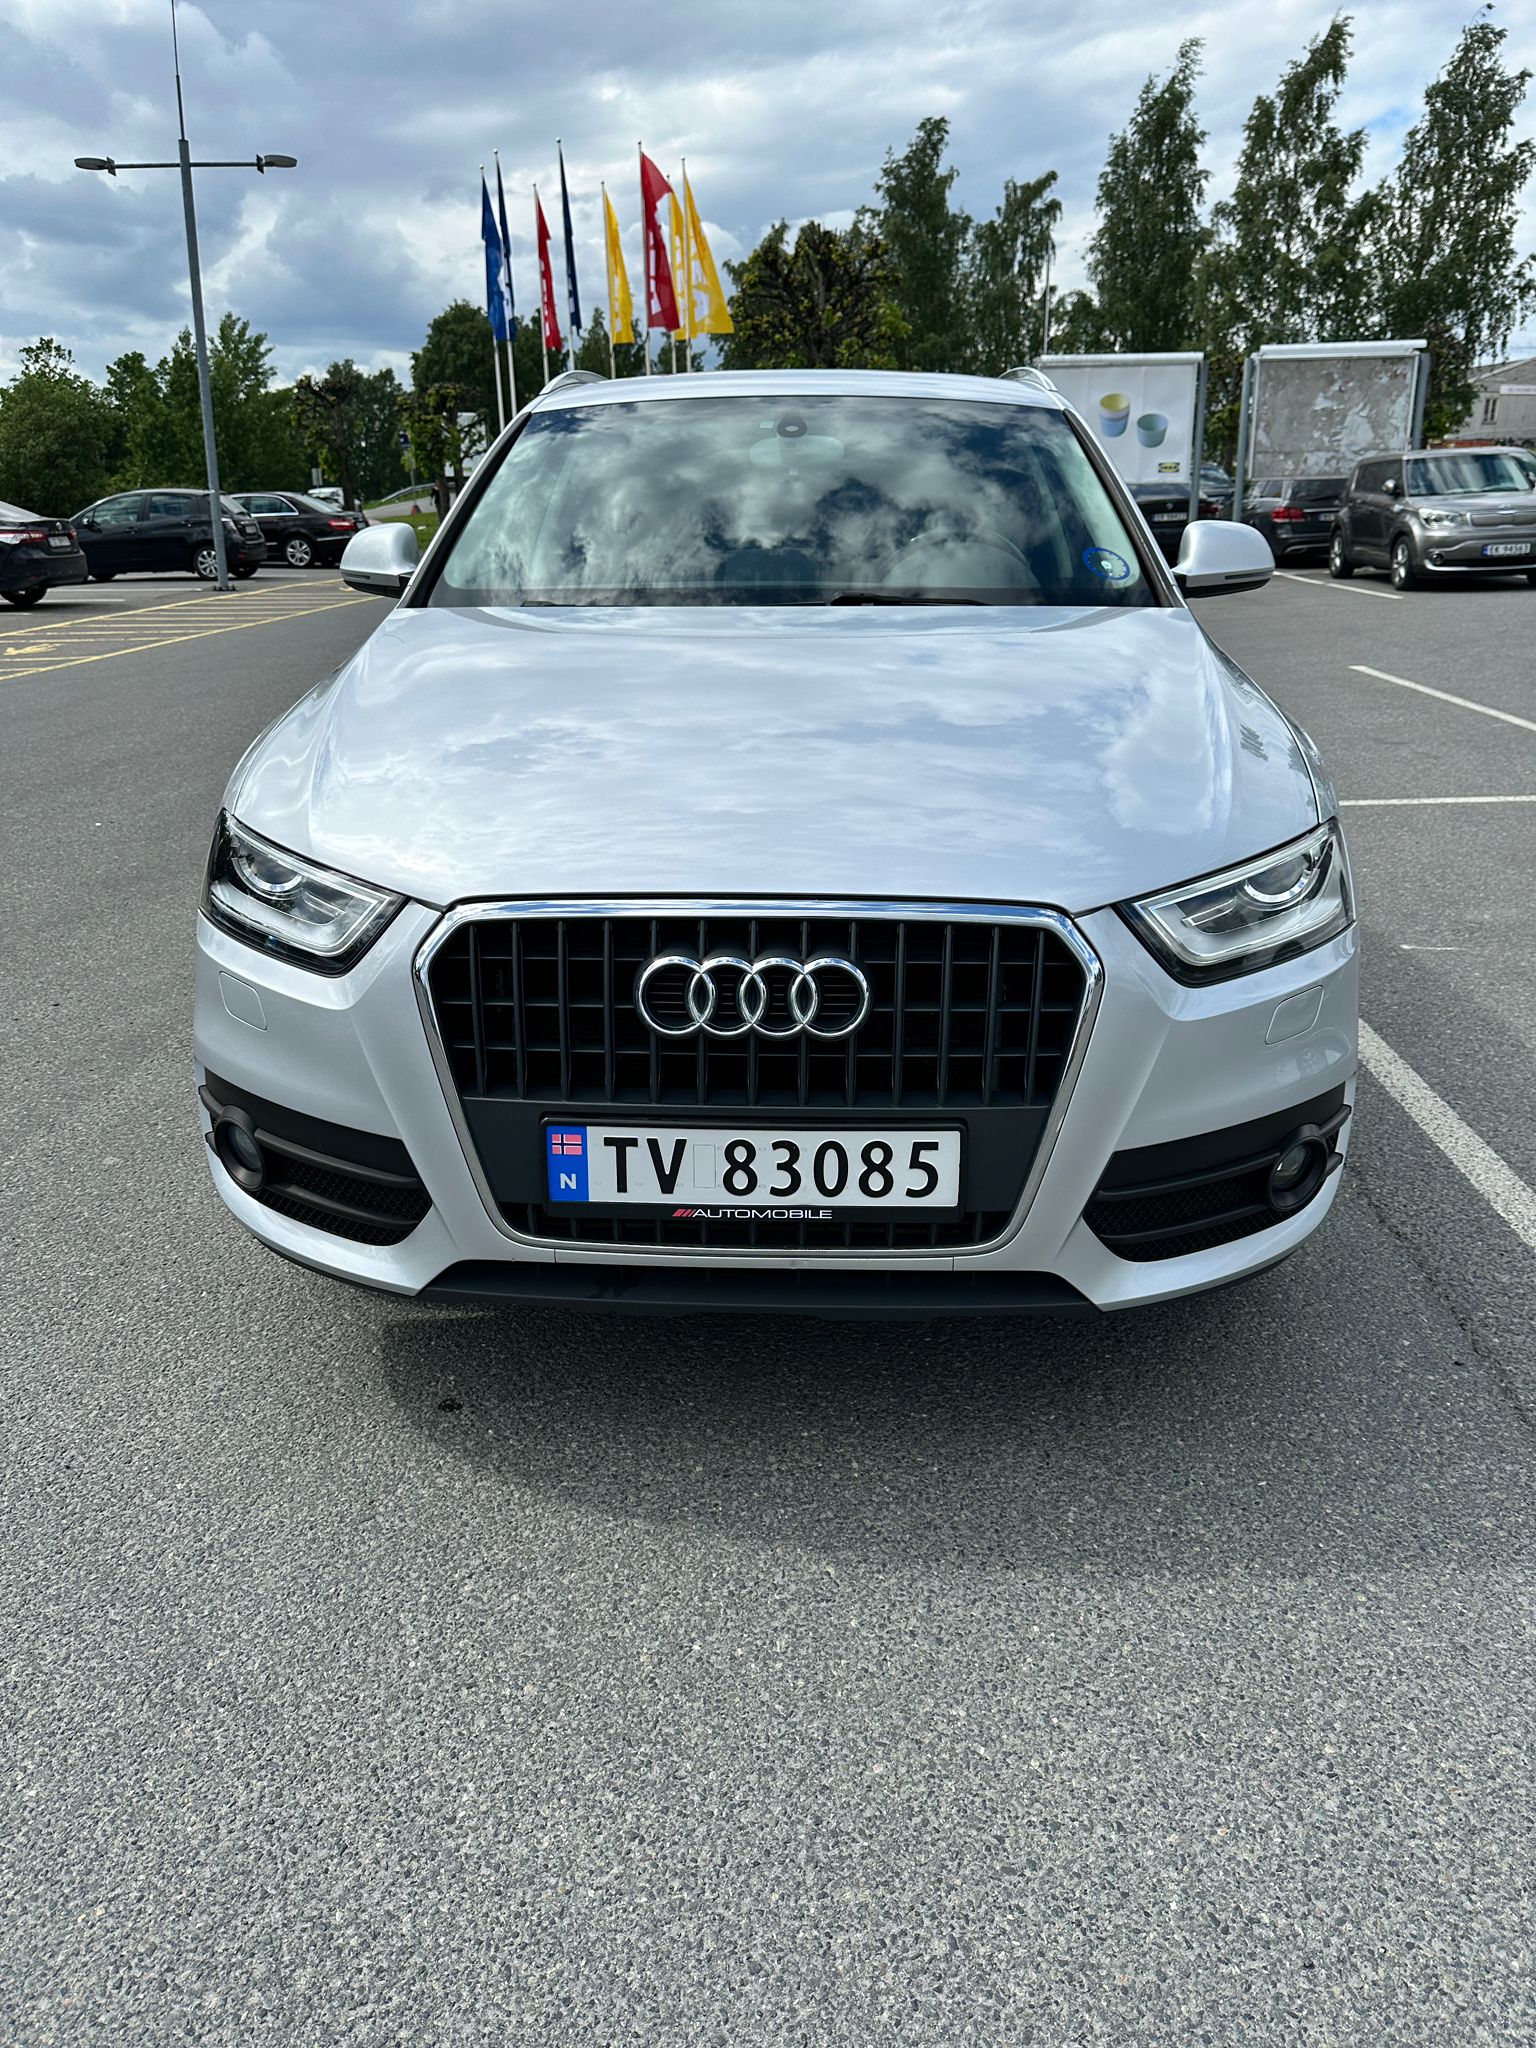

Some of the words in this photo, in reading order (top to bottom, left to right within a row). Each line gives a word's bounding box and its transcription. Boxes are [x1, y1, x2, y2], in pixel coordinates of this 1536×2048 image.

[603, 1136, 688, 1195] TV
[722, 1138, 939, 1198] 83085
[560, 1172, 577, 1190] N
[691, 1208, 833, 1219] AUTOMOBILE
